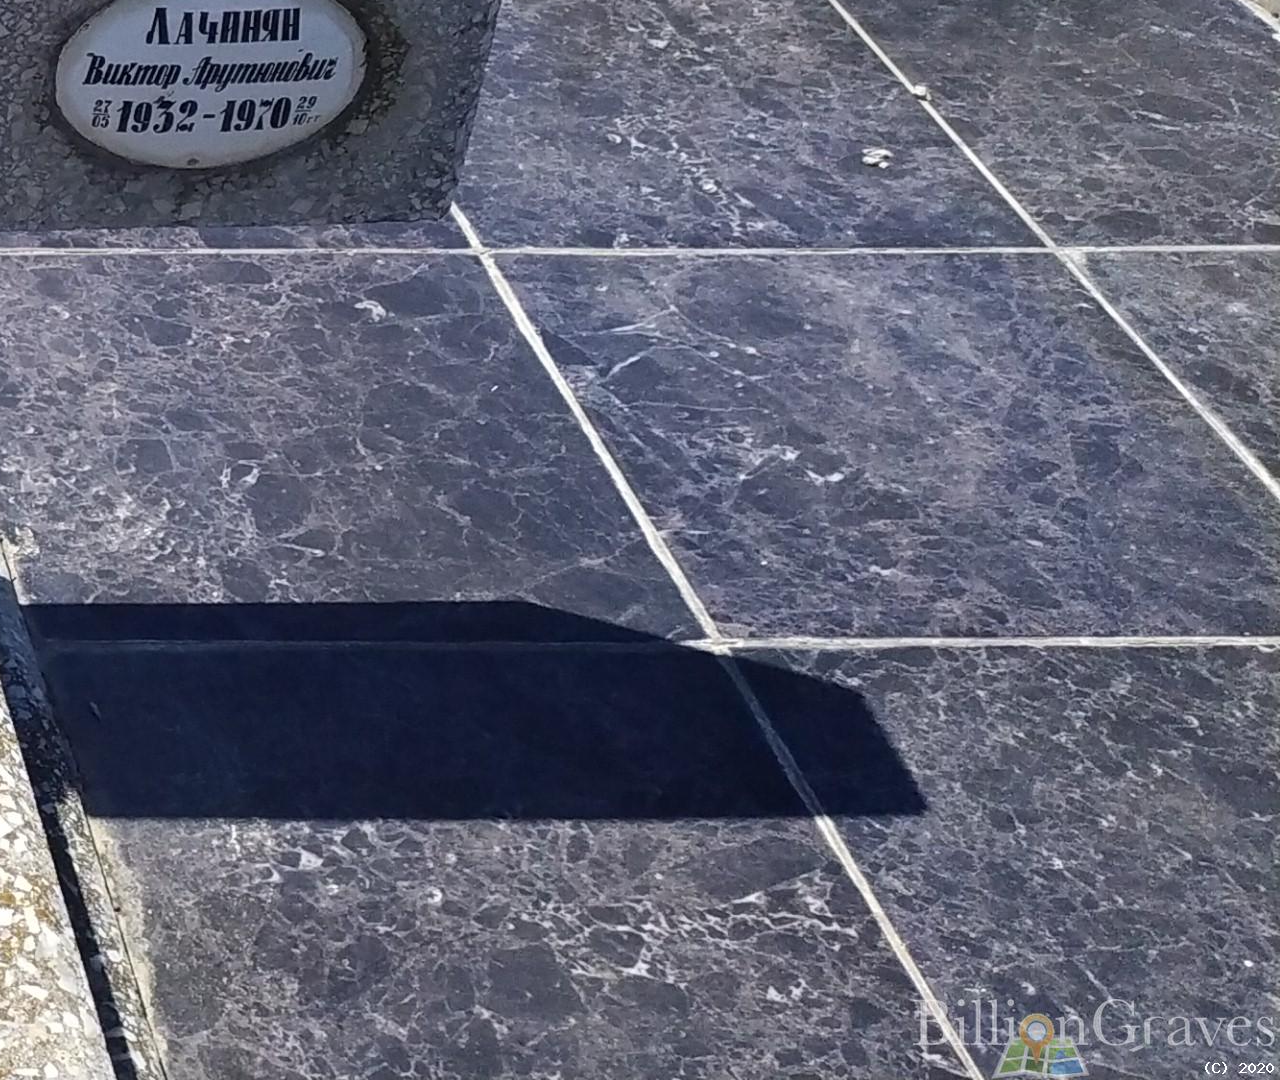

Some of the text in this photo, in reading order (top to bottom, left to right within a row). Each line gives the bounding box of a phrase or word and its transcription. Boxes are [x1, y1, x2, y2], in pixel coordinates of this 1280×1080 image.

[146, 7, 301, 45] ЛАЧИНЯН
[82, 48, 339, 92] Виктор Арутюнович
